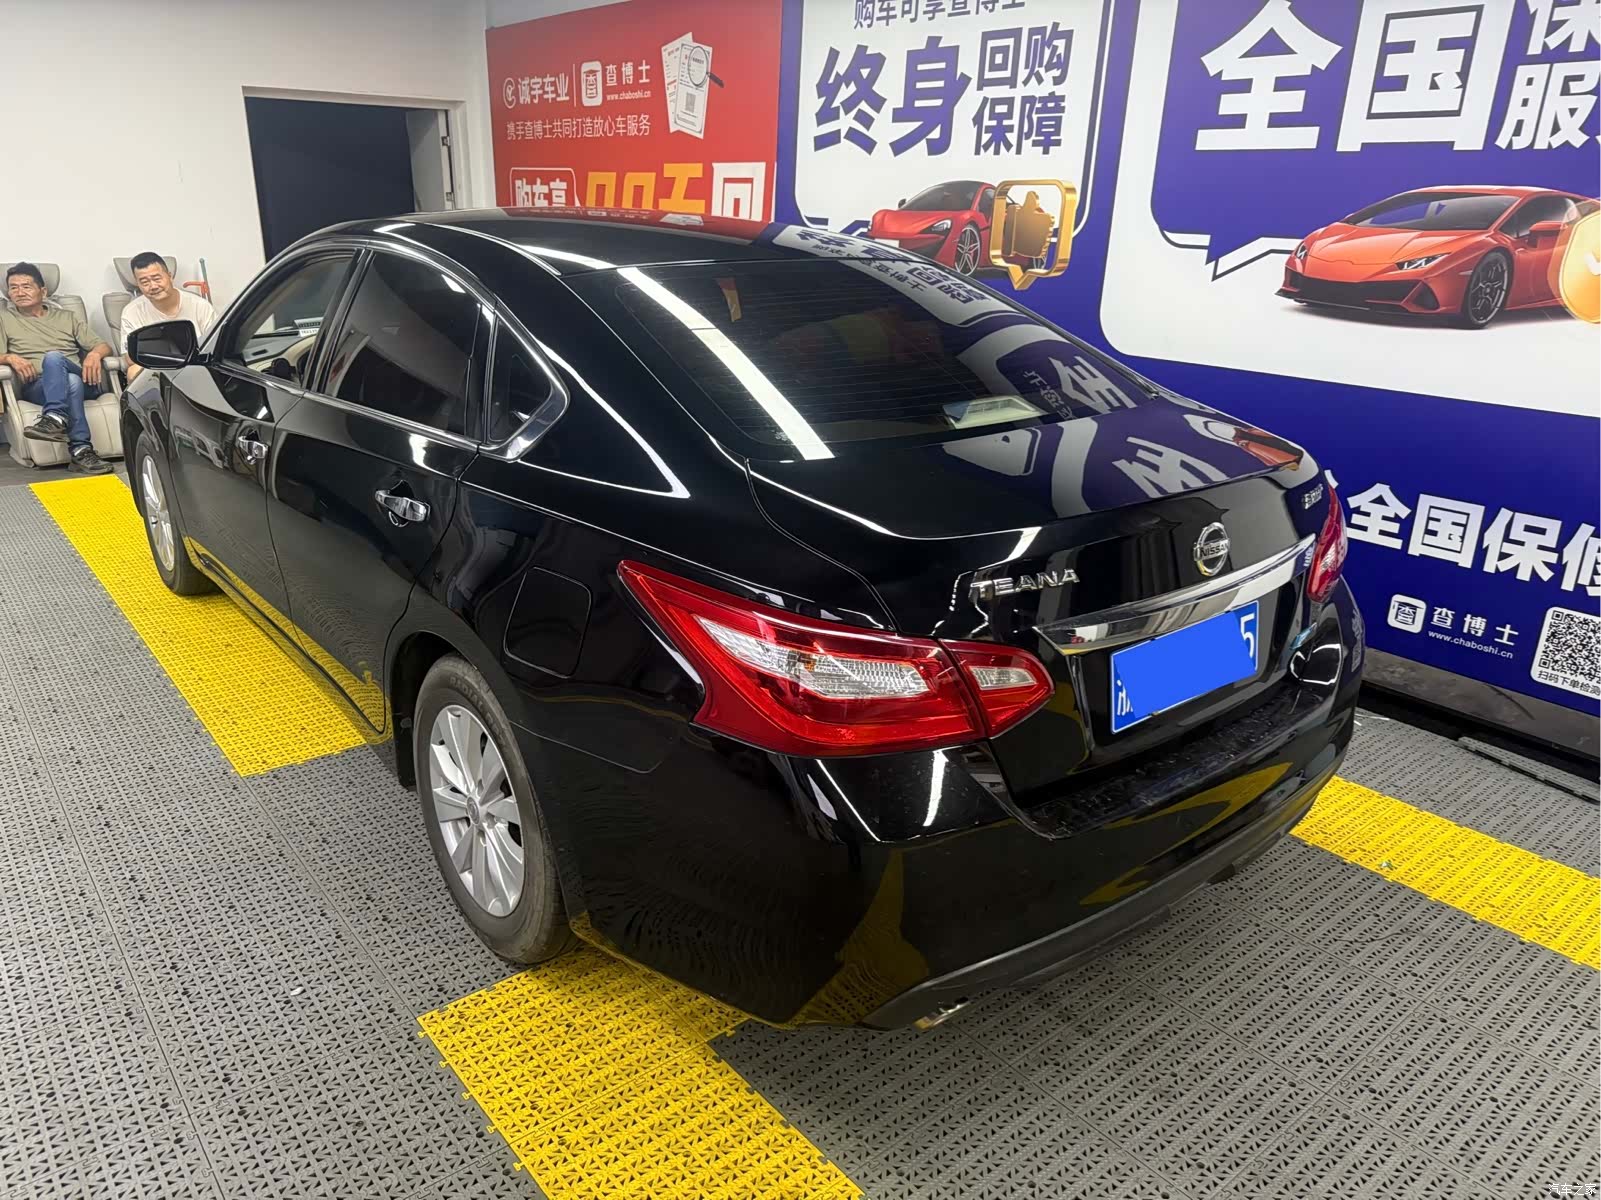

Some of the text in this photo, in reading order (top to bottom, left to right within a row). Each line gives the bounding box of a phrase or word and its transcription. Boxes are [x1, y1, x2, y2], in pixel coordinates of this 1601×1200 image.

[605, 59, 651, 86] 查博士
[976, 21, 1074, 91] 回购
[518, 73, 570, 105] 诚宇车业
[1195, 0, 1513, 151] 全国
[606, 90, 651, 101] www.chaboshi.cn
[813, 35, 972, 157] 终身
[1495, 60, 1600, 149] 服
[506, 113, 651, 141] 携手查博士共同打造放心车服务
[972, 91, 1066, 155] 保障
[1324, 469, 1600, 597] 全国保修
[970, 568, 1080, 598] TEANA
[1430, 606, 1519, 646] 查博士
[1428, 630, 1514, 659] www.chaboshi.cn
[1538, 670, 1600, 696] 扫码下单检测
